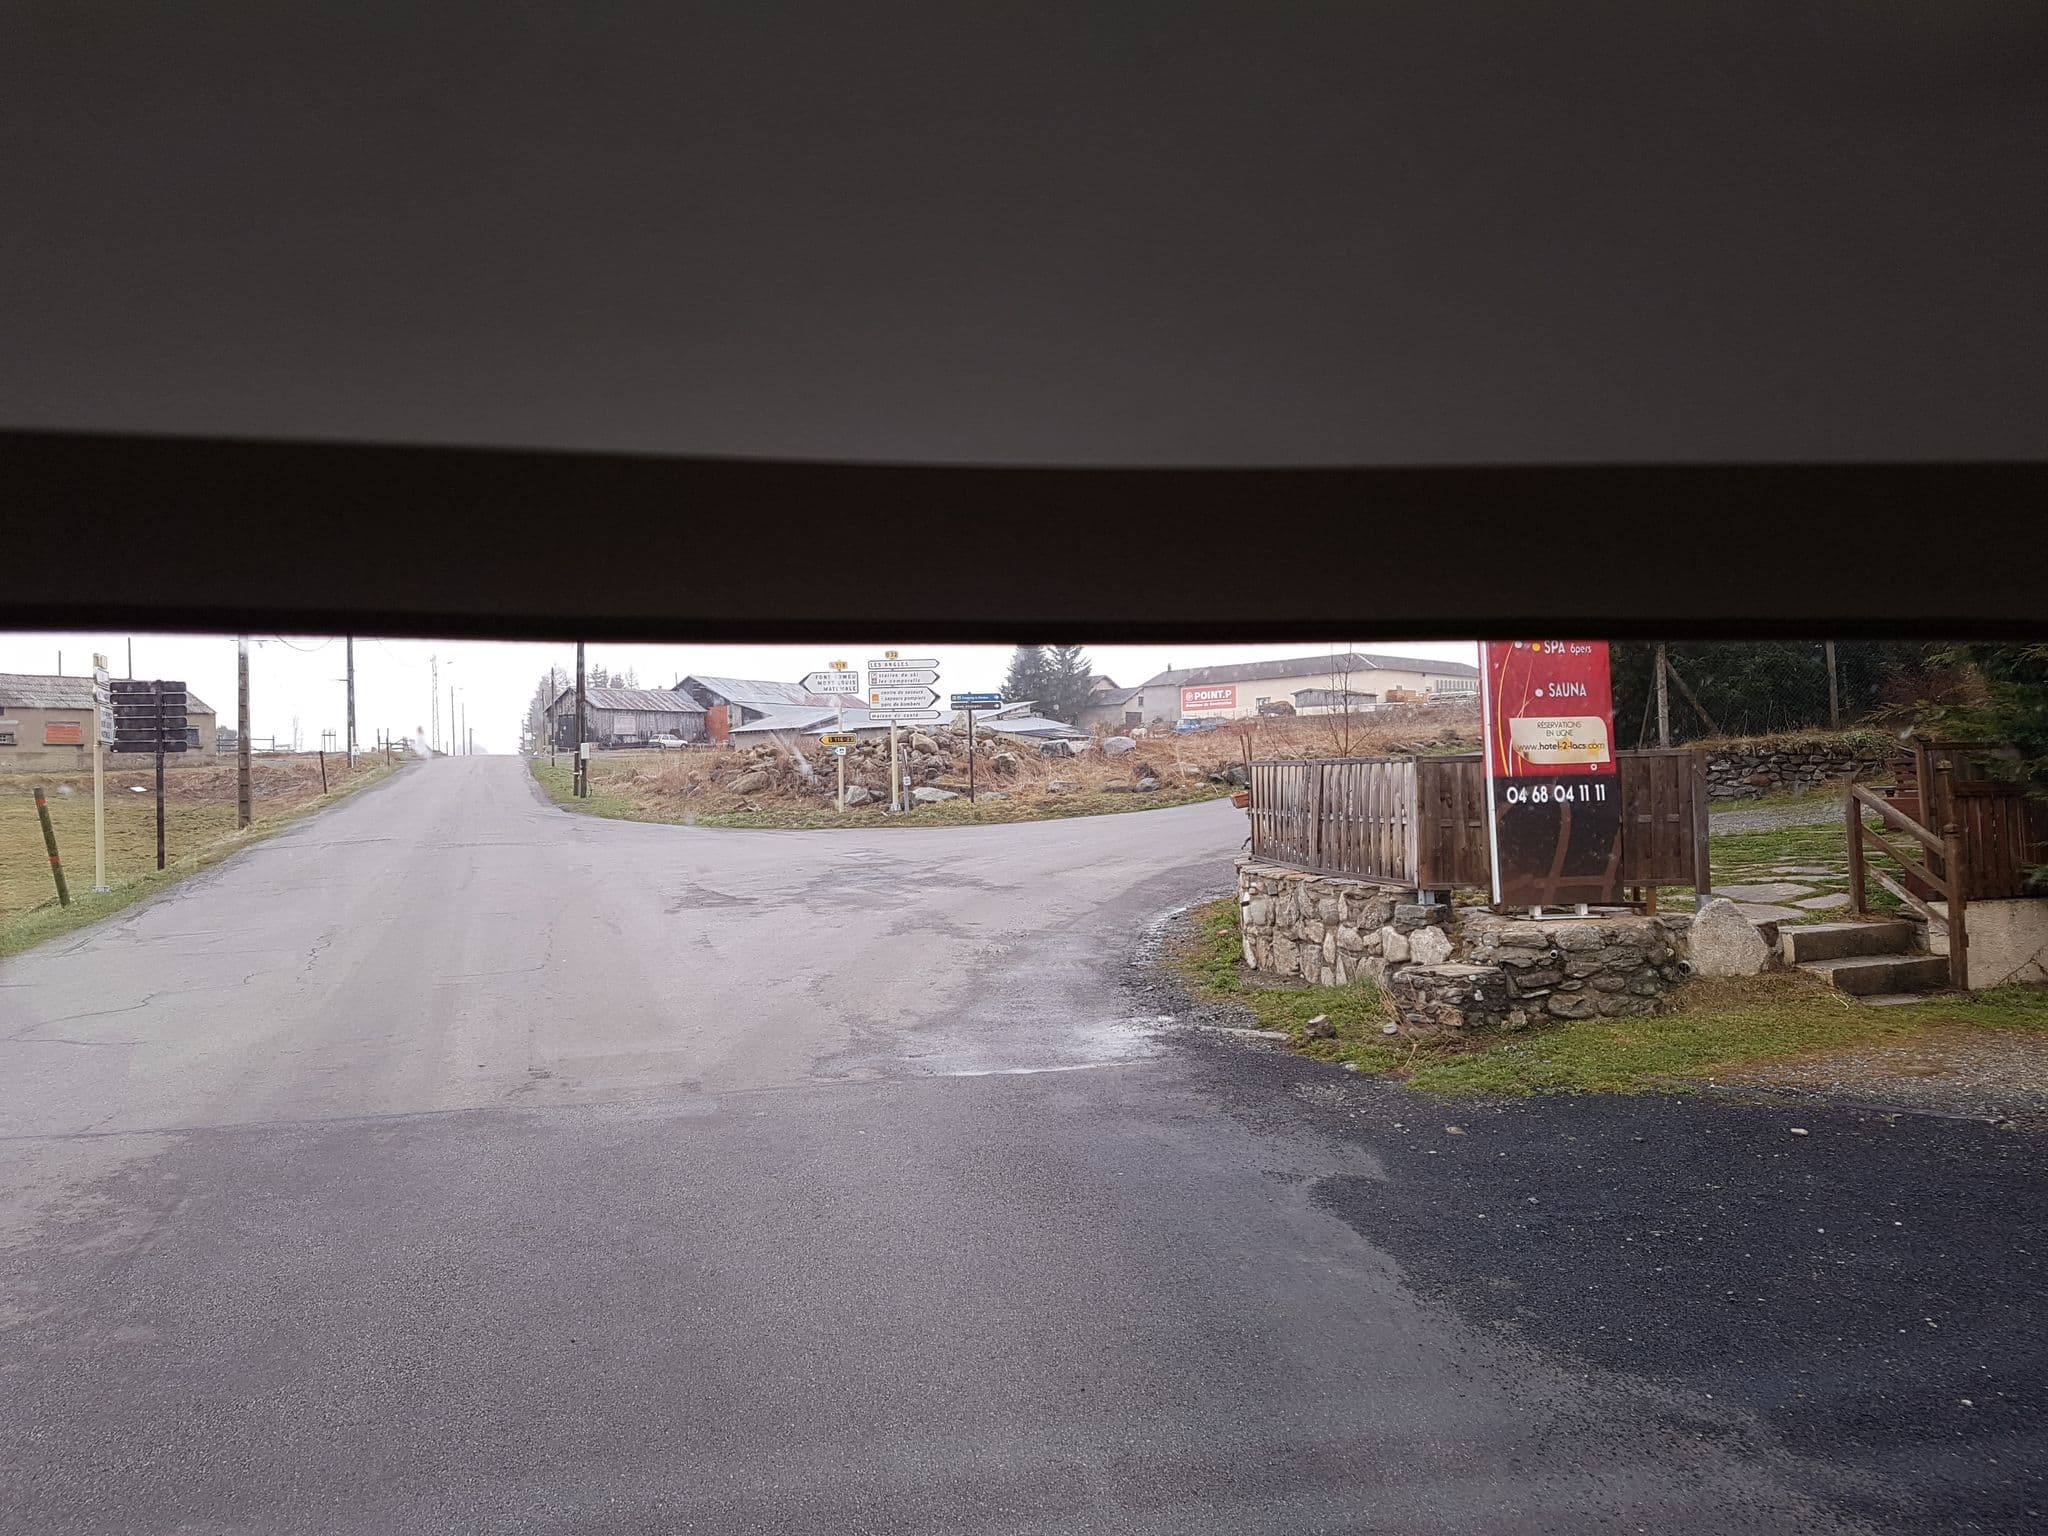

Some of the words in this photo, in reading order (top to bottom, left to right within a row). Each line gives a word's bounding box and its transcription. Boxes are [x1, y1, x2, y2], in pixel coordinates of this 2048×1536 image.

[1544, 641, 1565, 654] SPA
[1570, 643, 1592, 655] 6pers
[1194, 689, 1232, 700] POINT.P
[1548, 682, 1587, 697] SAUNA
[1536, 720, 1582, 729] RÉSERVATIONS
[1546, 729, 1555, 737] EN
[1556, 729, 1574, 737] LIGNE
[1517, 740, 1605, 751] www.hotel-2-lacs.com
[1507, 785, 1527, 804] 04
[1532, 785, 1549, 803] 68
[1553, 785, 1575, 802] 04
[1579, 785, 1590, 801] 11
[1594, 783, 1606, 801] 11
